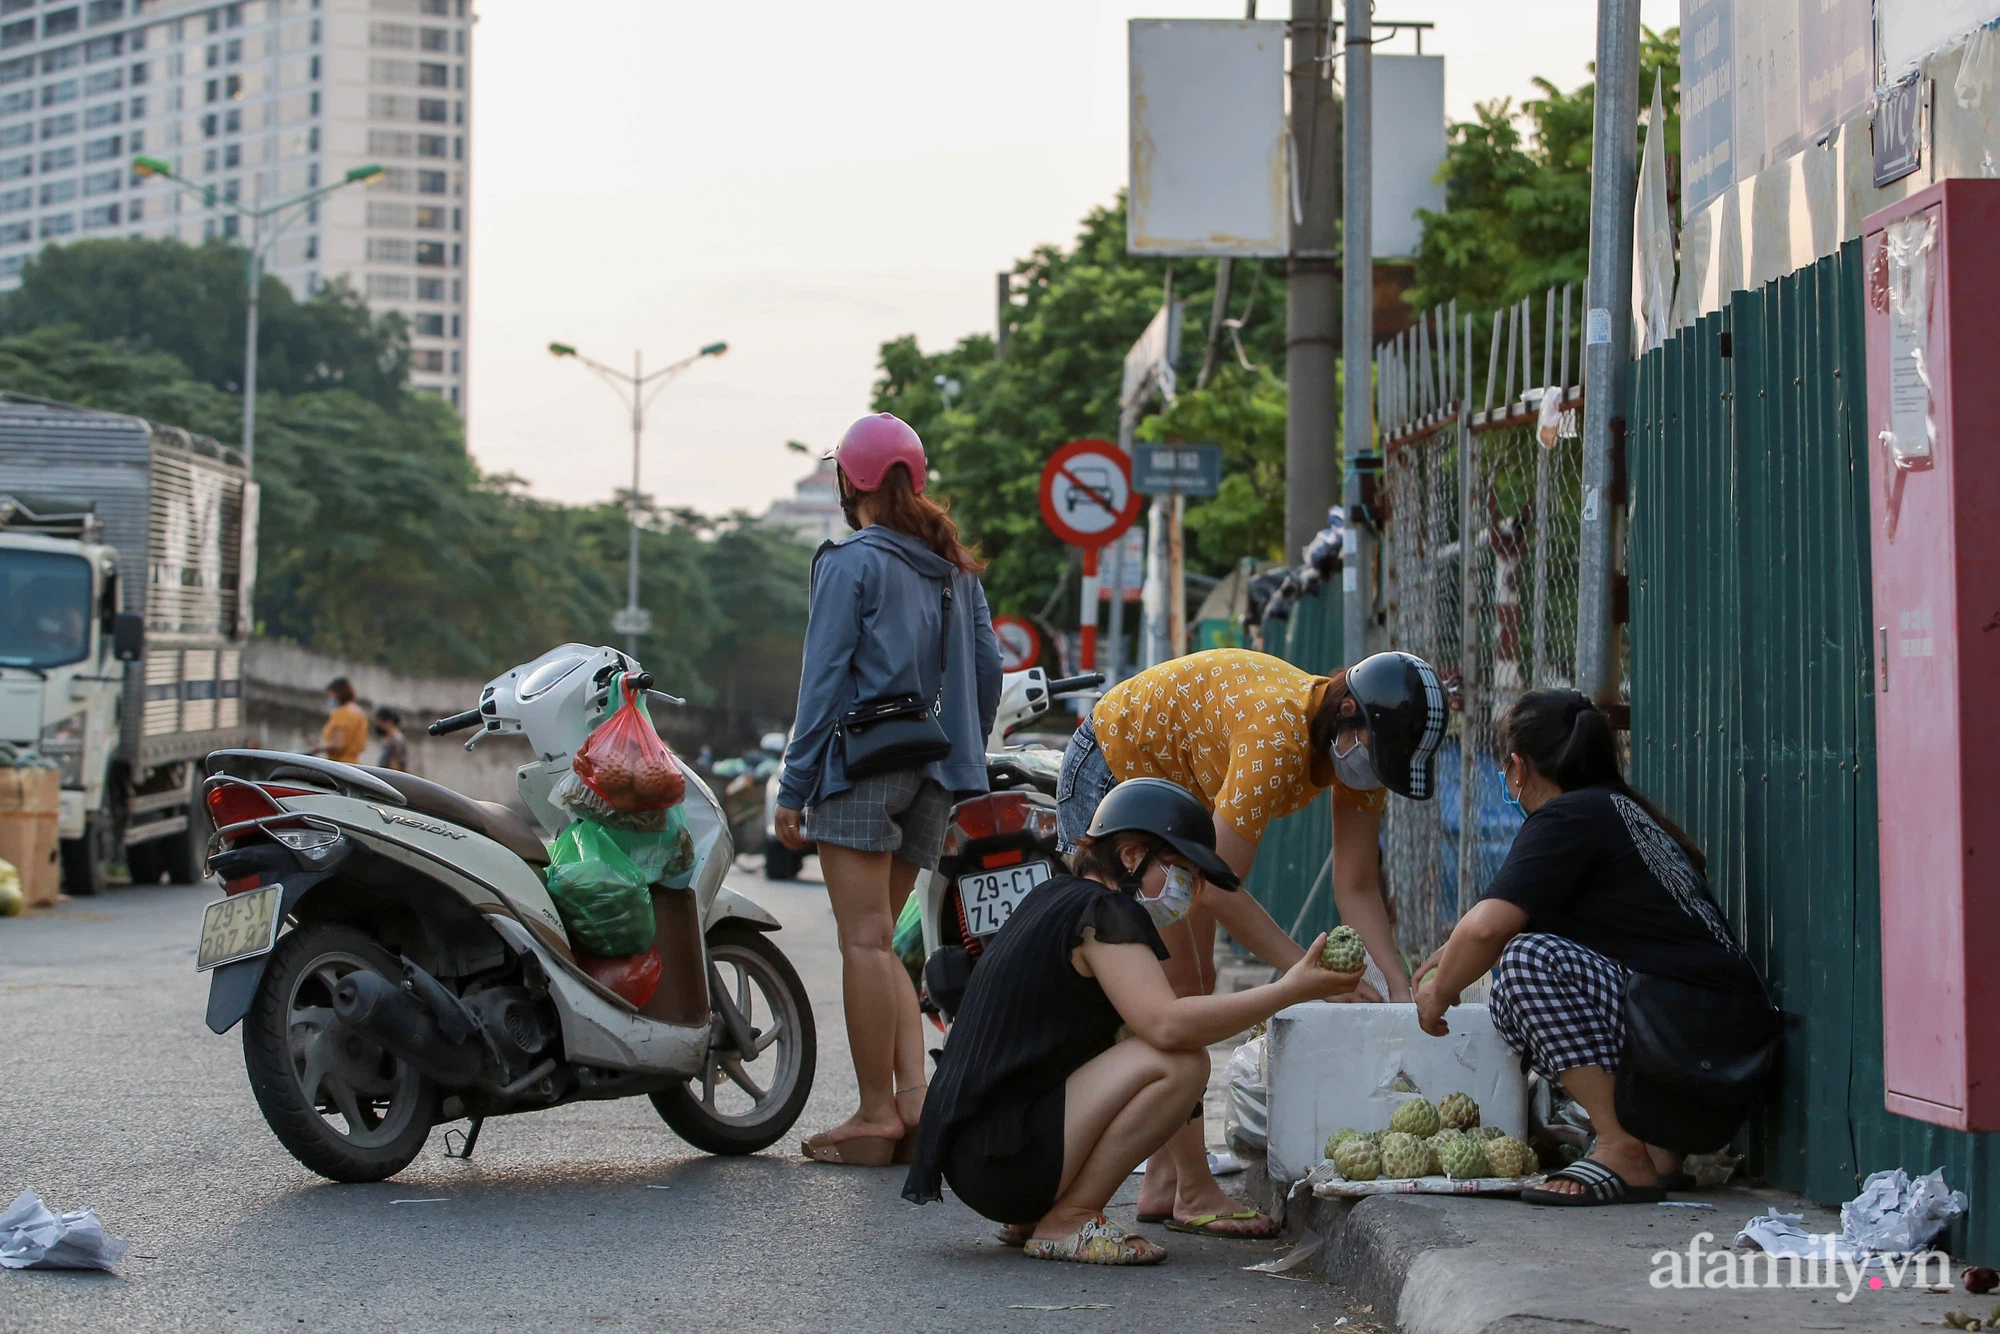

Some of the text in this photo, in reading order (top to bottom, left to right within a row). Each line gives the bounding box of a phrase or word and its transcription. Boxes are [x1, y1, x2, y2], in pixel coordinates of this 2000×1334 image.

[1881, 92, 1908, 153] WC
[973, 868, 1036, 903] 29-C1
[211, 890, 267, 931] 29-S1
